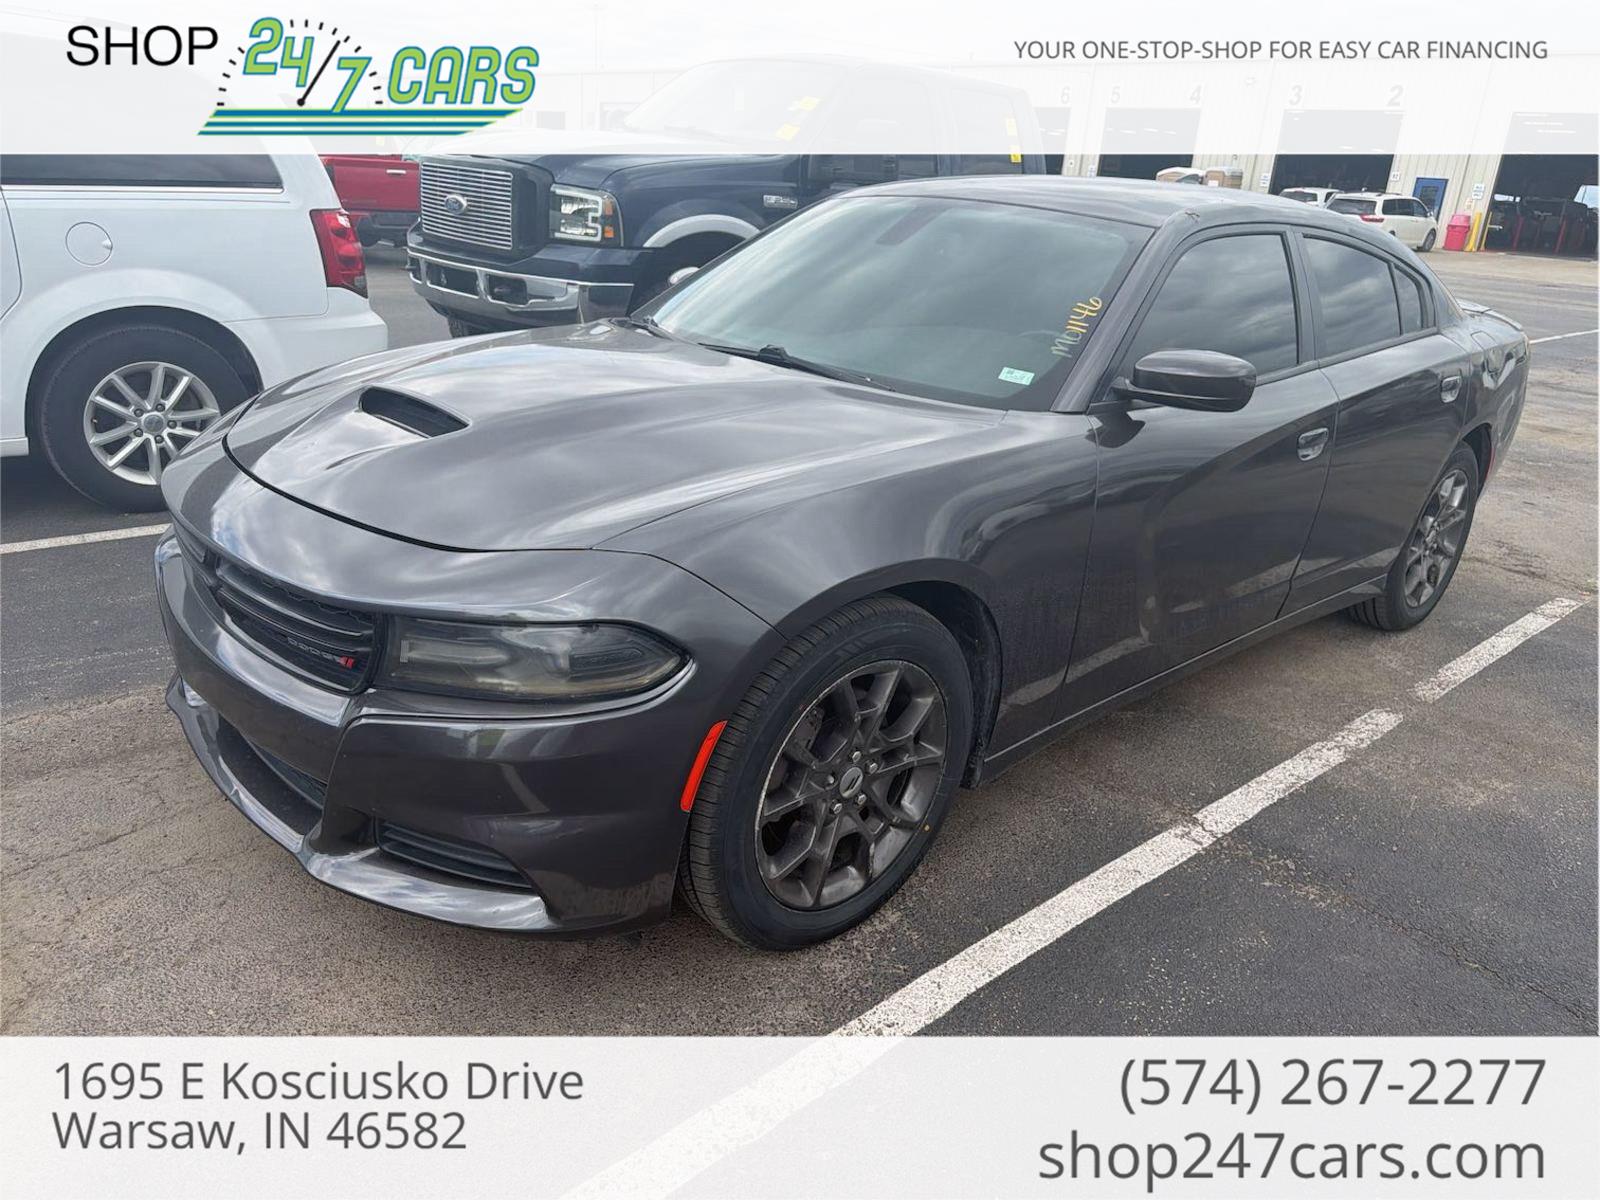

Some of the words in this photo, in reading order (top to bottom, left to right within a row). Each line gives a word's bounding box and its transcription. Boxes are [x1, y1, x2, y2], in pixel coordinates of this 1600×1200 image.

[1060, 85, 1071, 105] 6
[1110, 85, 1121, 104] 5
[1189, 84, 1202, 105] 4
[1288, 84, 1303, 106] 3
[1386, 84, 1404, 107] 2
